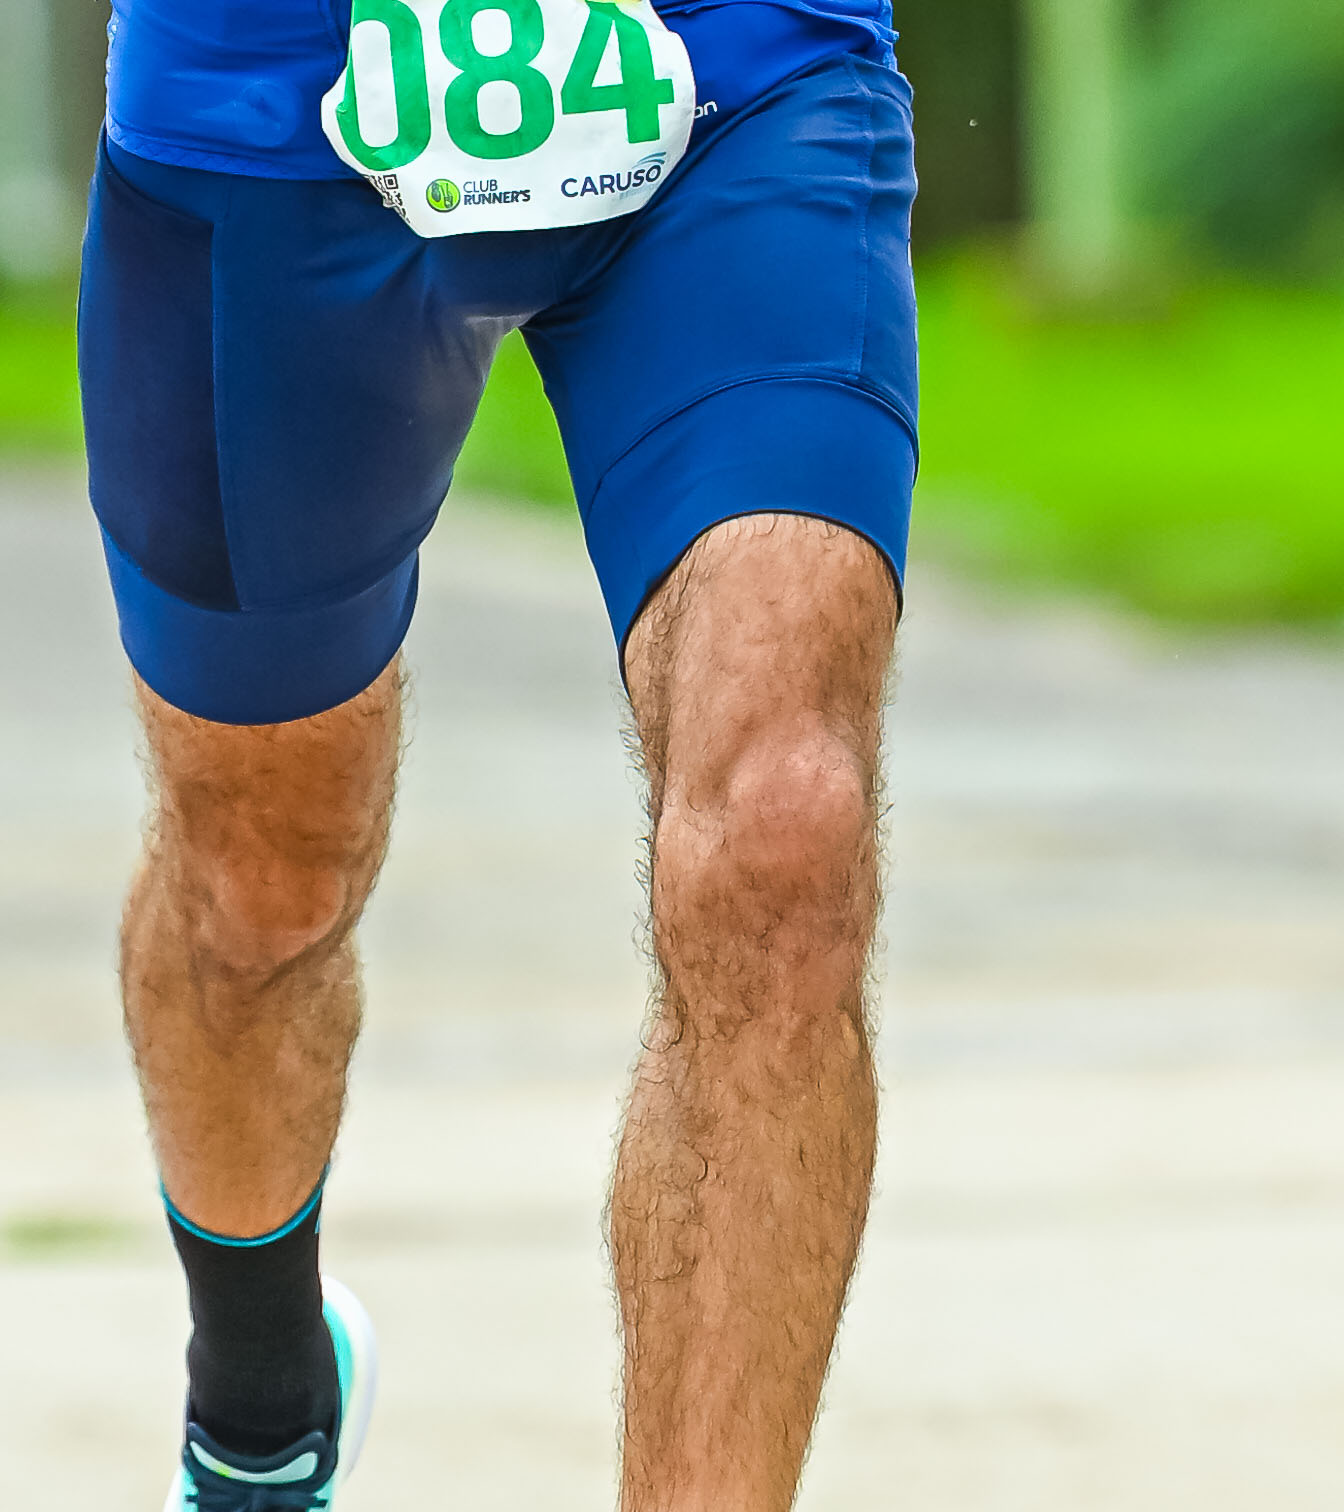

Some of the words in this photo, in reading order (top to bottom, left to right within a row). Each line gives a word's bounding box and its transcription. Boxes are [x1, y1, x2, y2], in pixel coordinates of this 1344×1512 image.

[463, 179, 498, 193] CLUB
[560, 164, 662, 198] CARUSO
[463, 189, 531, 206] RUNNER'S
